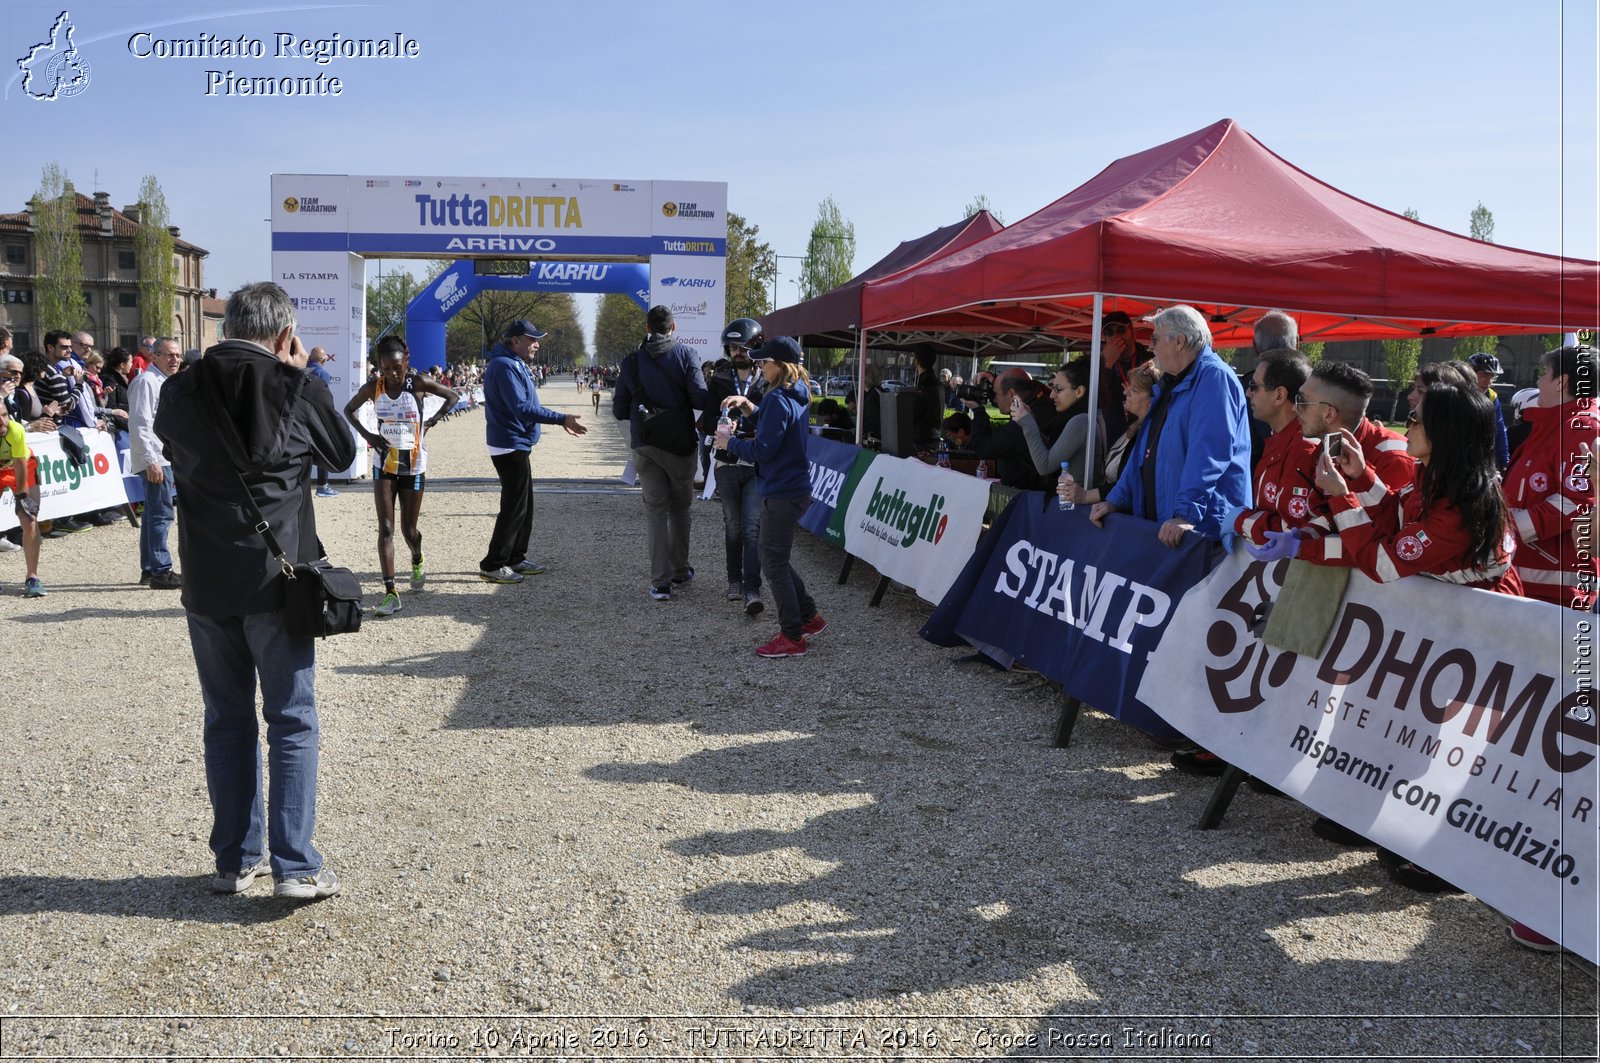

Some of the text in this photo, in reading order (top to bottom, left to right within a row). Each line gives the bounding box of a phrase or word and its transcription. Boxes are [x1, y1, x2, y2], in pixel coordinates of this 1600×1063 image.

[300, 197, 319, 205] TEAM
[678, 202, 697, 211] TEAM
[300, 205, 337, 213] MARATHON
[415, 193, 583, 229] TuttaDRITTA
[677, 210, 715, 219] MARATHON
[446, 237, 556, 251] ARRIVO
[663, 240, 715, 253] TuttaDRITTA
[282, 272, 339, 281] LA STAMPA
[537, 263, 609, 281] KARHU
[678, 278, 717, 288] KARHU
[300, 297, 336, 306] REALE
[440, 286, 468, 313] KARHU
[865, 476, 948, 548] battaglio
[994, 539, 1171, 654] STAMP
[1307, 689, 1599, 829] ASTE IMMOBILIAR
[1290, 724, 1580, 886] Risparmi con Giudizio.
